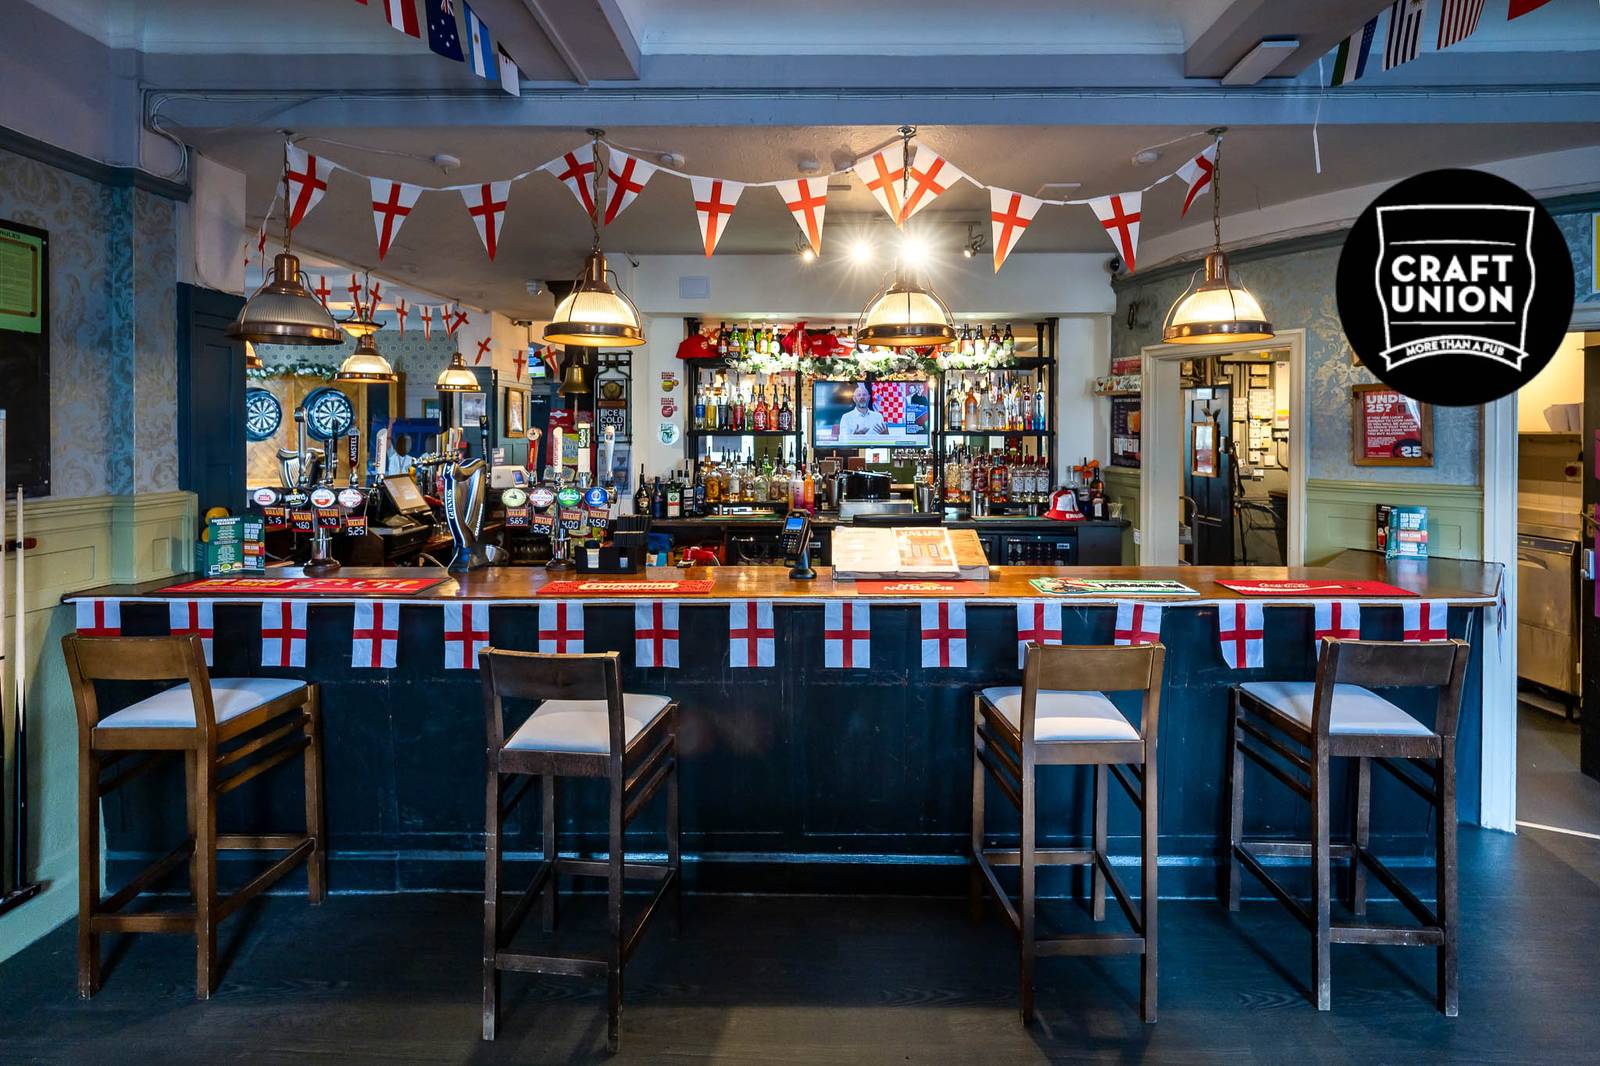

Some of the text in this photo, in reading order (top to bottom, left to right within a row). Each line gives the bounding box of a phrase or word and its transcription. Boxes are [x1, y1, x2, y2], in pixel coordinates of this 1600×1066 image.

[1366, 394, 1408, 404] UNDE
[602, 409, 620, 417] ICE
[1367, 403, 1392, 413] 25?
[600, 416, 624, 424] COLD
[600, 423, 623, 432] SOT
[350, 435, 358, 462] AMSTEL
[1401, 446, 1422, 458] 25
[562, 520, 579, 530] 4.00
[589, 518, 607, 528] 4.50
[347, 527, 365, 536] 5.25
[533, 524, 550, 534] 5.25
